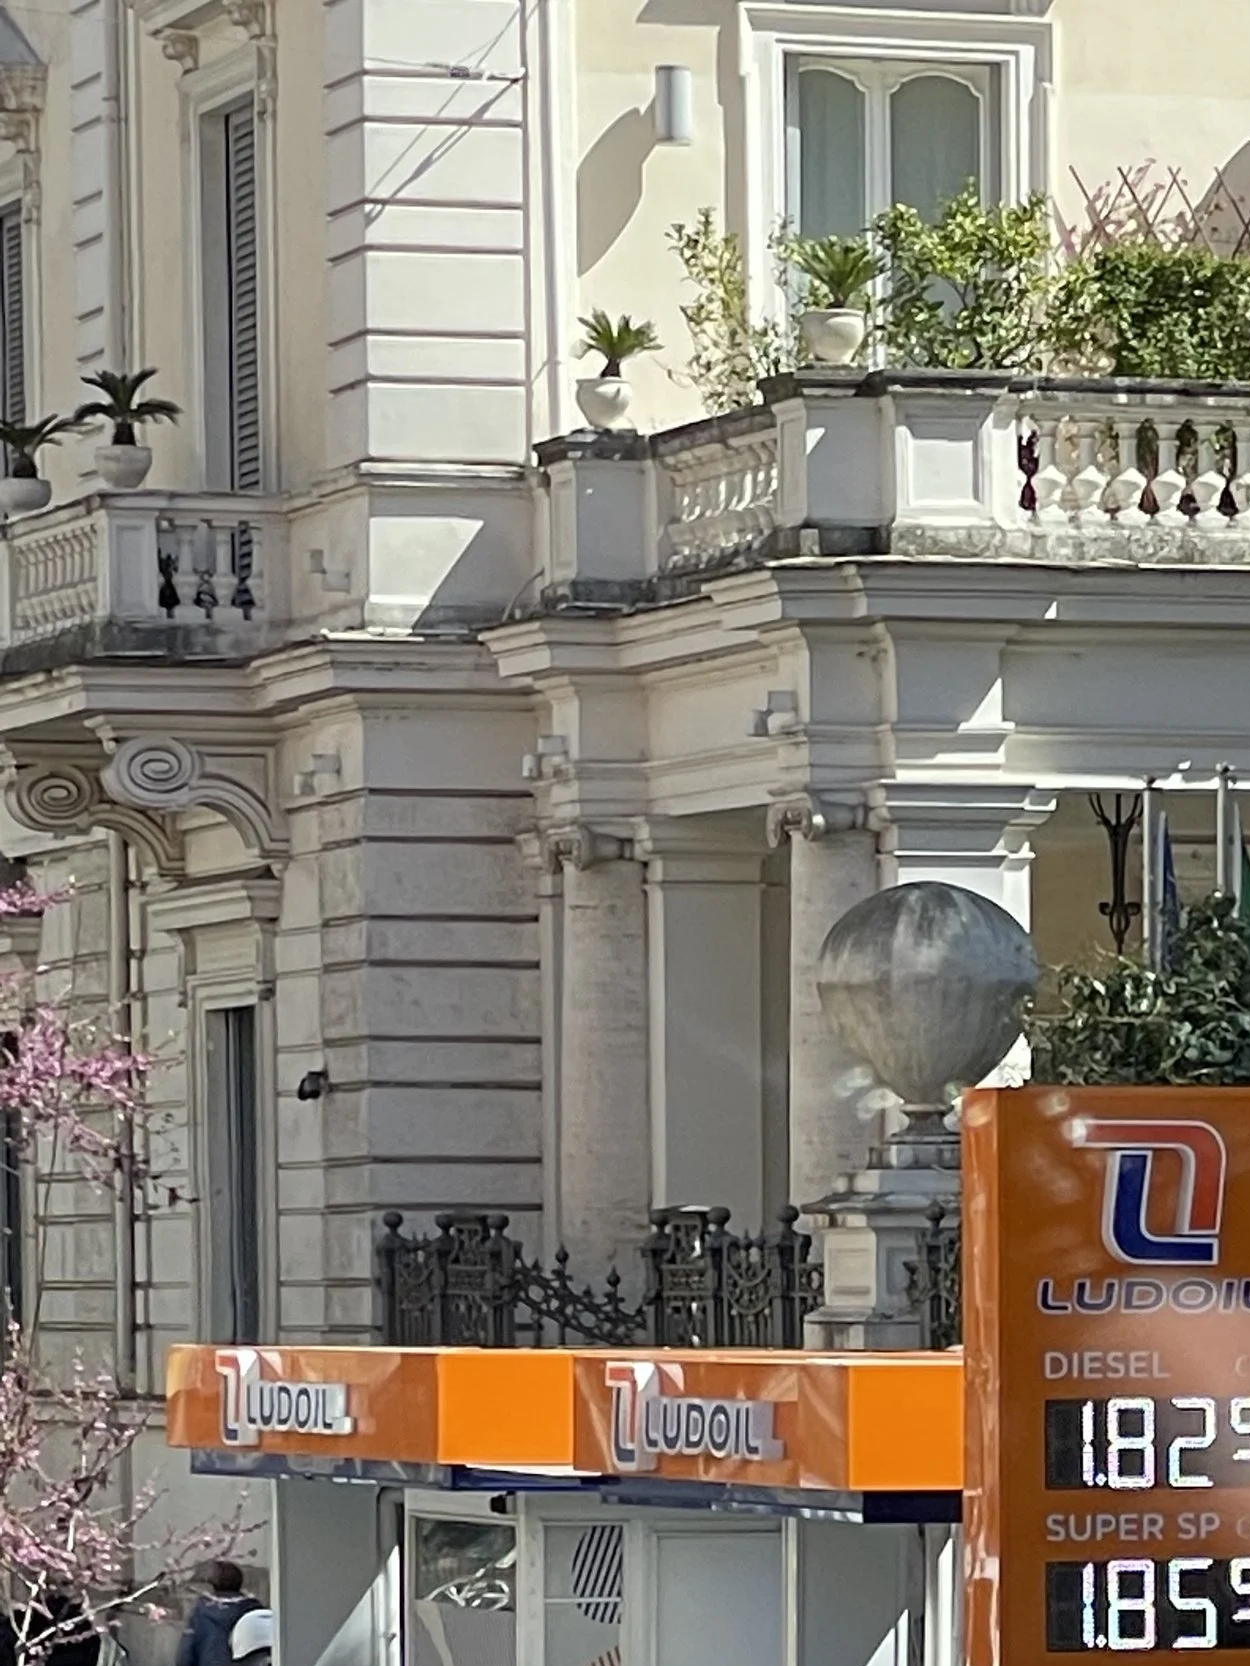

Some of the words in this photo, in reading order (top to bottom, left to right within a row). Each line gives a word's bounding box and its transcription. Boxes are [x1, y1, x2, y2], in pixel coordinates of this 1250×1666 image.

[1044, 1351, 1171, 1379] DIESEL
[247, 1382, 336, 1431] LUDOIL
[644, 1399, 760, 1457] LUDOIL
[1046, 1513, 1164, 1542] SUPER
[1177, 1512, 1220, 1540] SP
